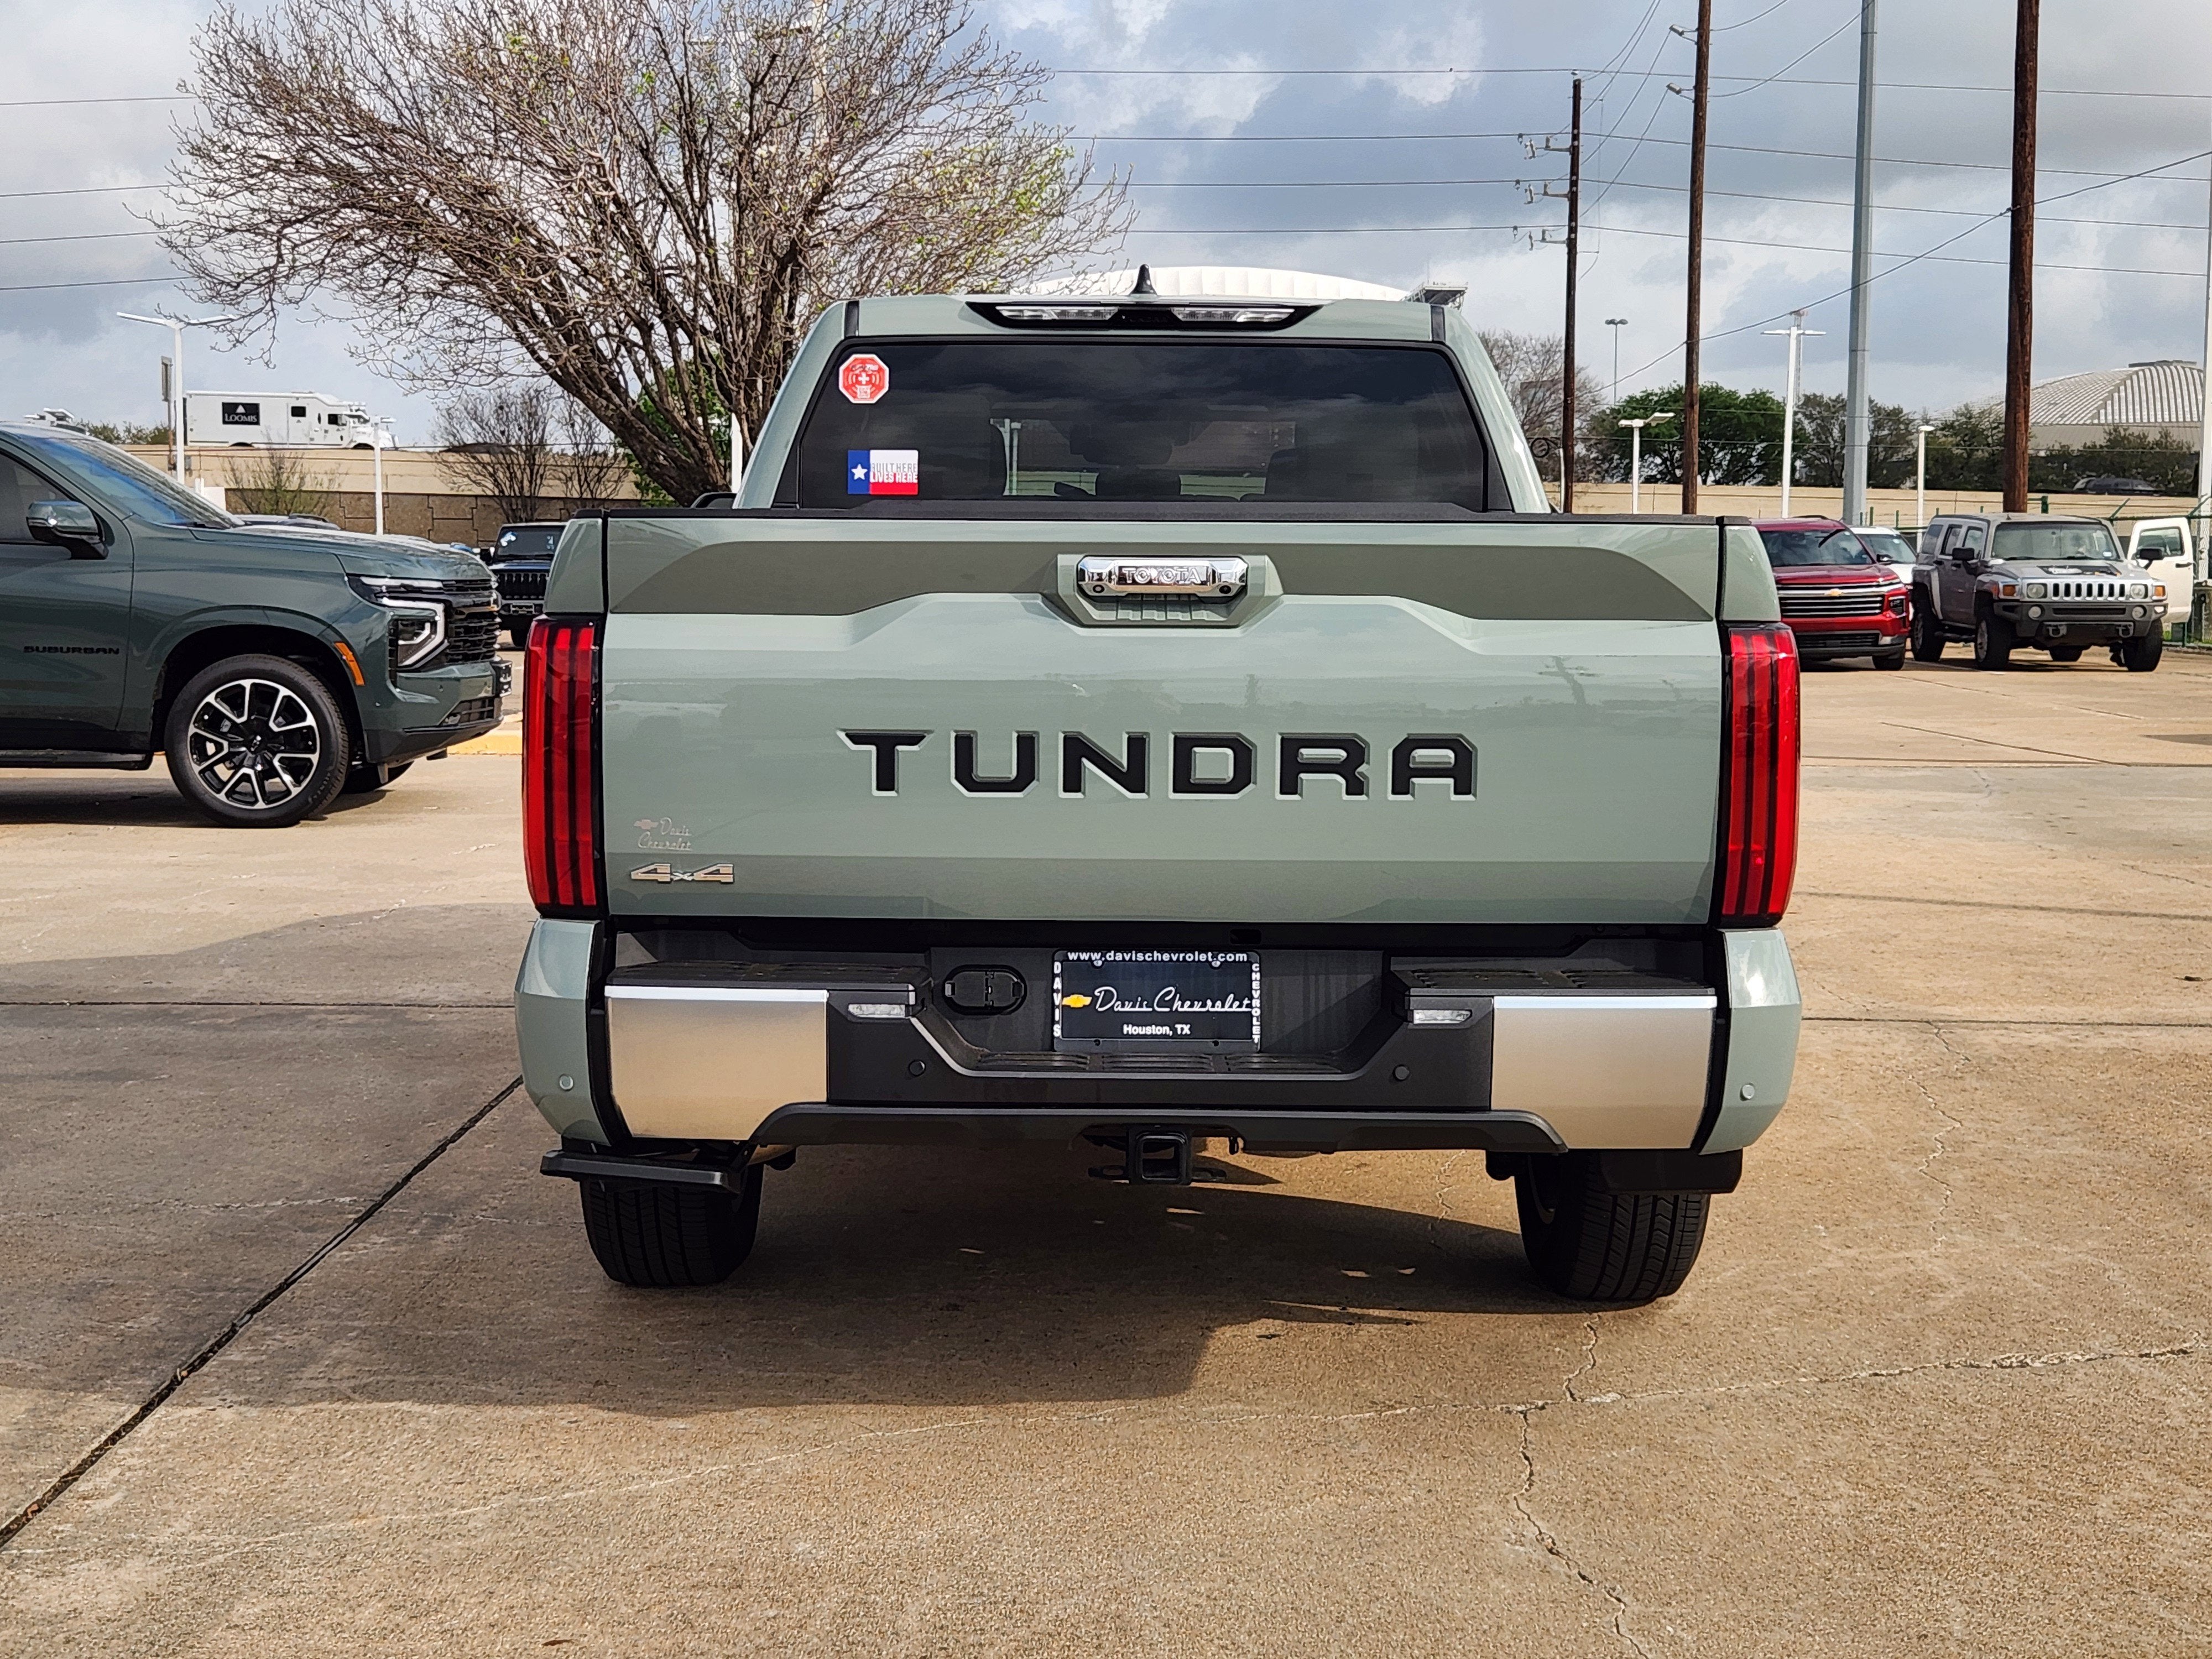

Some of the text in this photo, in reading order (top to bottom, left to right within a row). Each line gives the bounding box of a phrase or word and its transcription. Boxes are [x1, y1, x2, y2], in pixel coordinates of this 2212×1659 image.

[225, 413, 258, 422] LOOMIS
[896, 463, 917, 473] HERE
[895, 472, 917, 483] HERE
[1122, 567, 1201, 584] TOYOTA
[23, 646, 120, 655] SUBURBAN
[836, 729, 1478, 801] TUNDRA
[660, 817, 692, 836] Davis
[638, 831, 693, 851] Chevrolet
[630, 862, 735, 884] 4x4
[1067, 950, 1248, 962] www.davischevrolet.com
[1053, 961, 1062, 1037] DAVIS
[1094, 986, 1252, 1012] Davis Chevrolet
[1251, 963, 1261, 1044] CHEVROLET
[1123, 1024, 1191, 1037] Houston, TX
